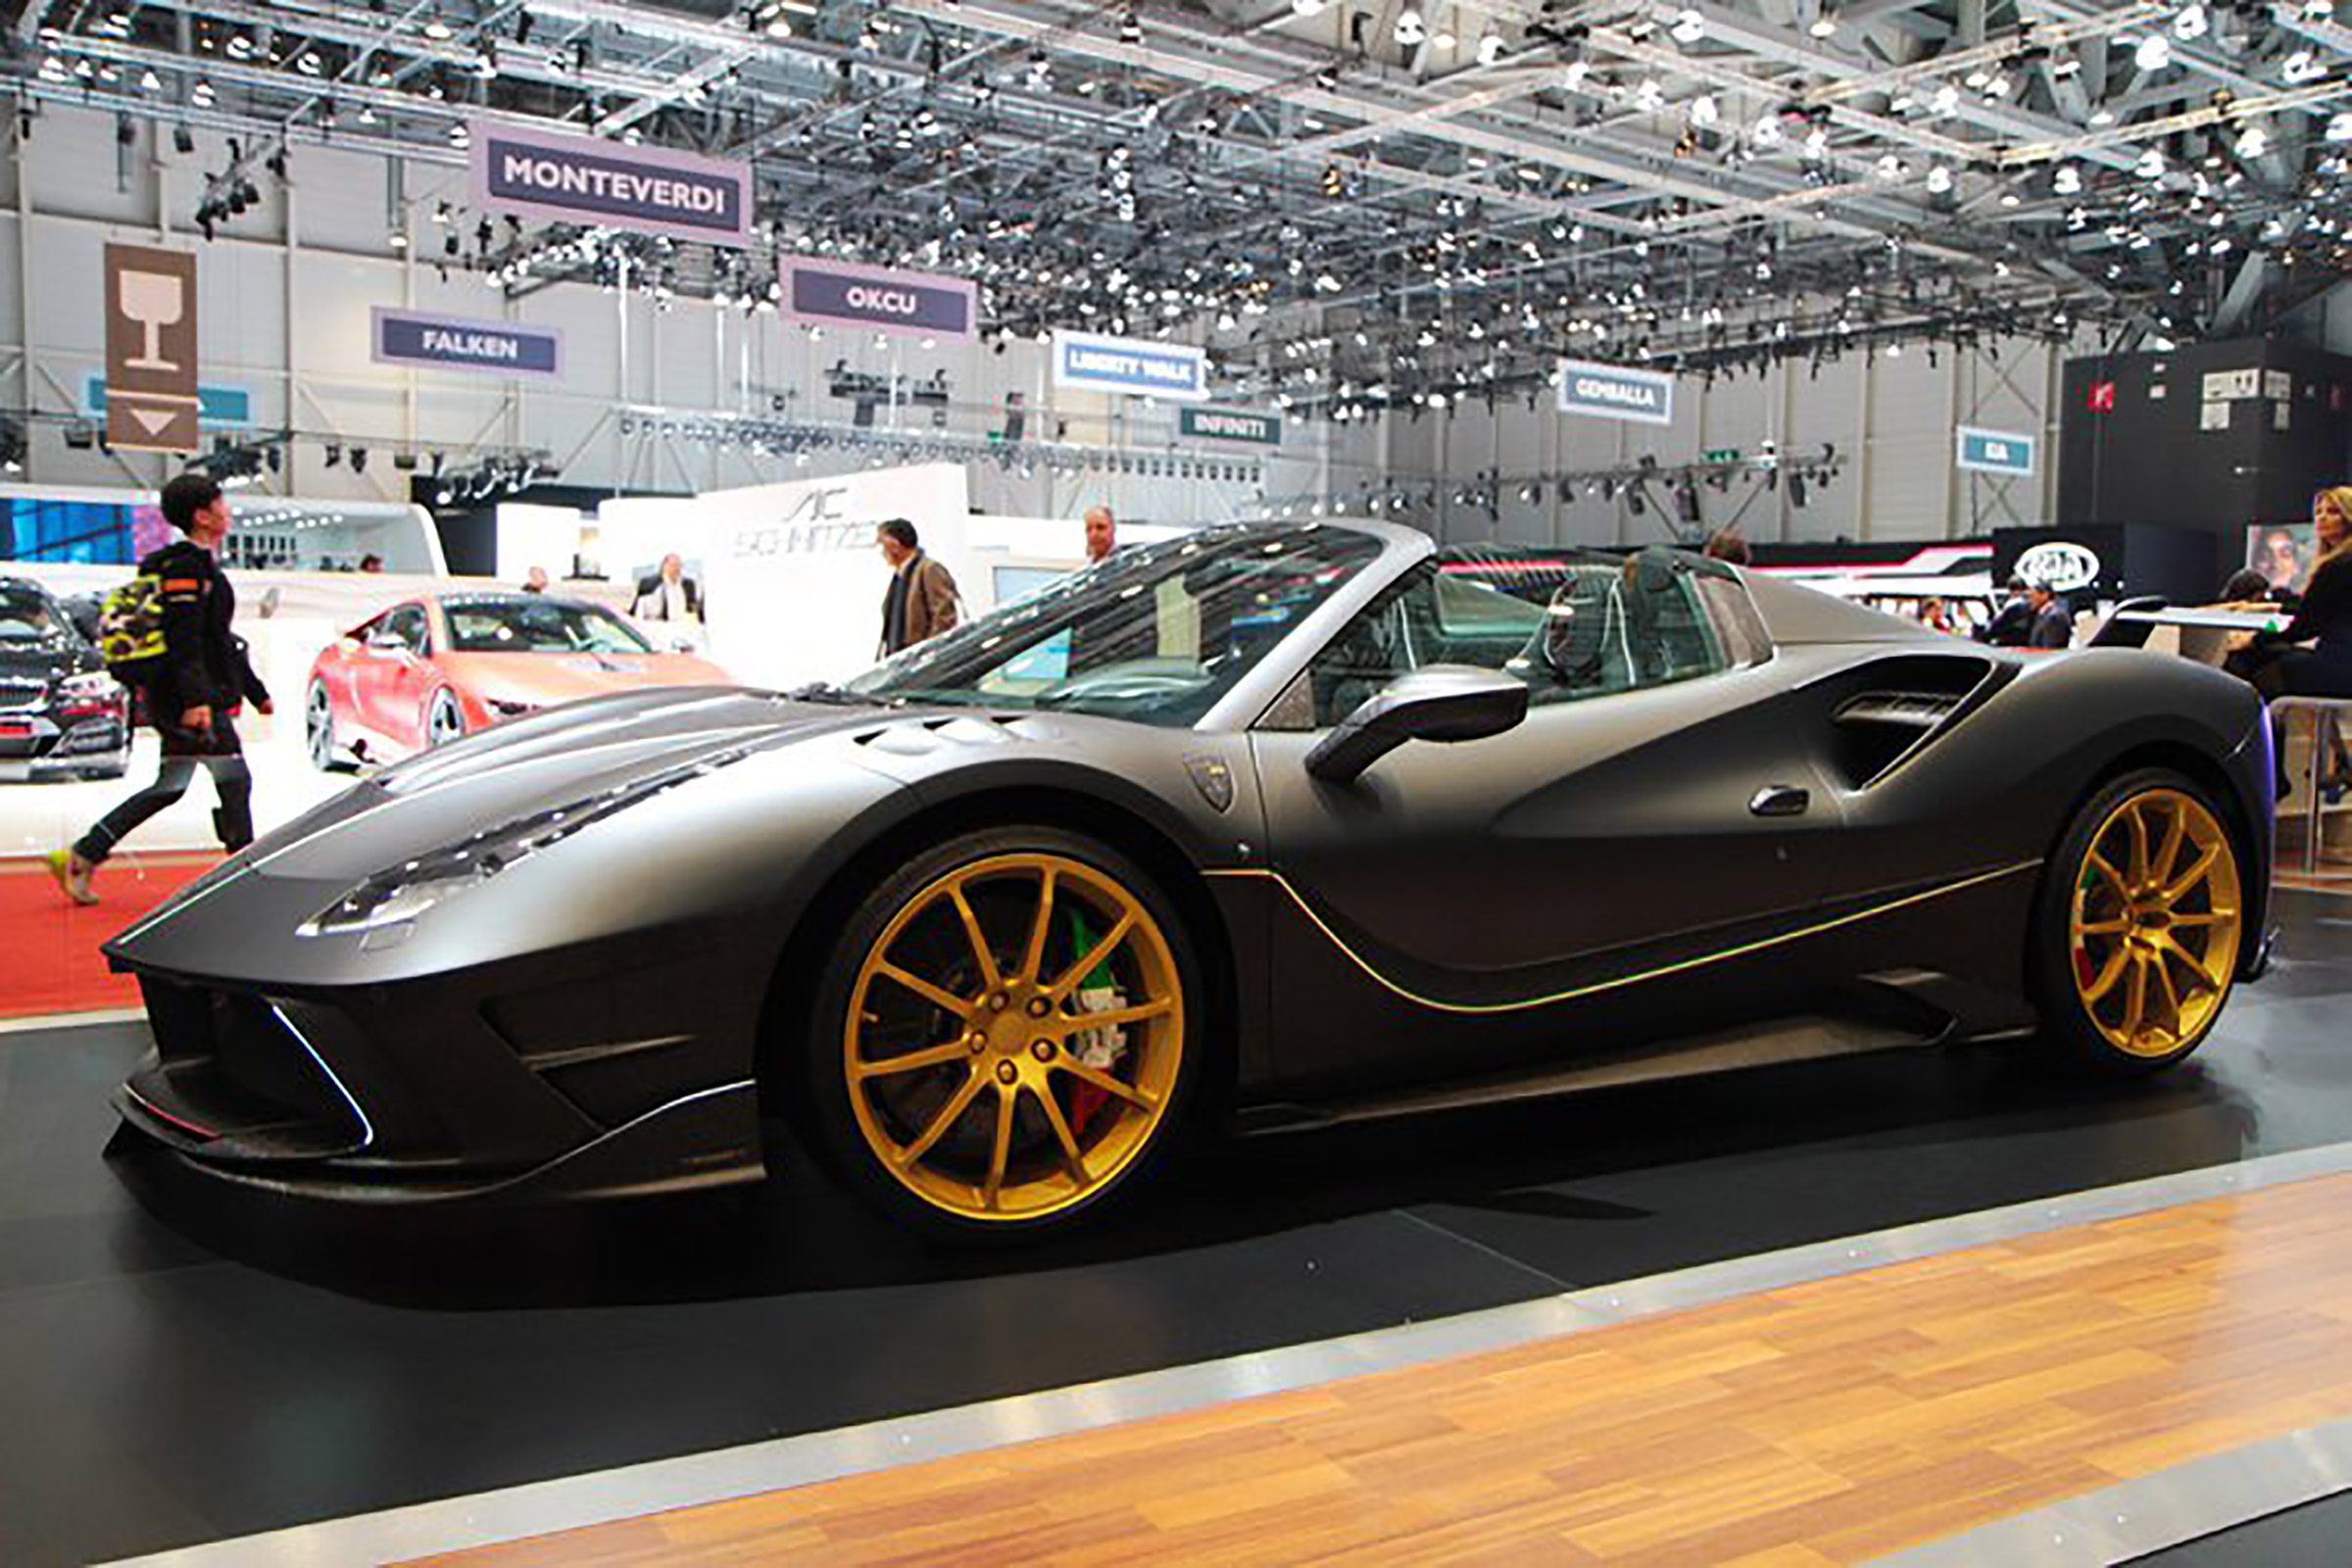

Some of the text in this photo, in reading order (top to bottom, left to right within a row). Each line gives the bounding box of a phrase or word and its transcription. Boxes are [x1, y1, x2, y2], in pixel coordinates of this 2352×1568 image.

[504, 155, 725, 215] MONTEVERDI
[847, 286, 915, 315] OKCU
[422, 330, 517, 360] FALKEN
[1194, 413, 1266, 438] INFINITI
